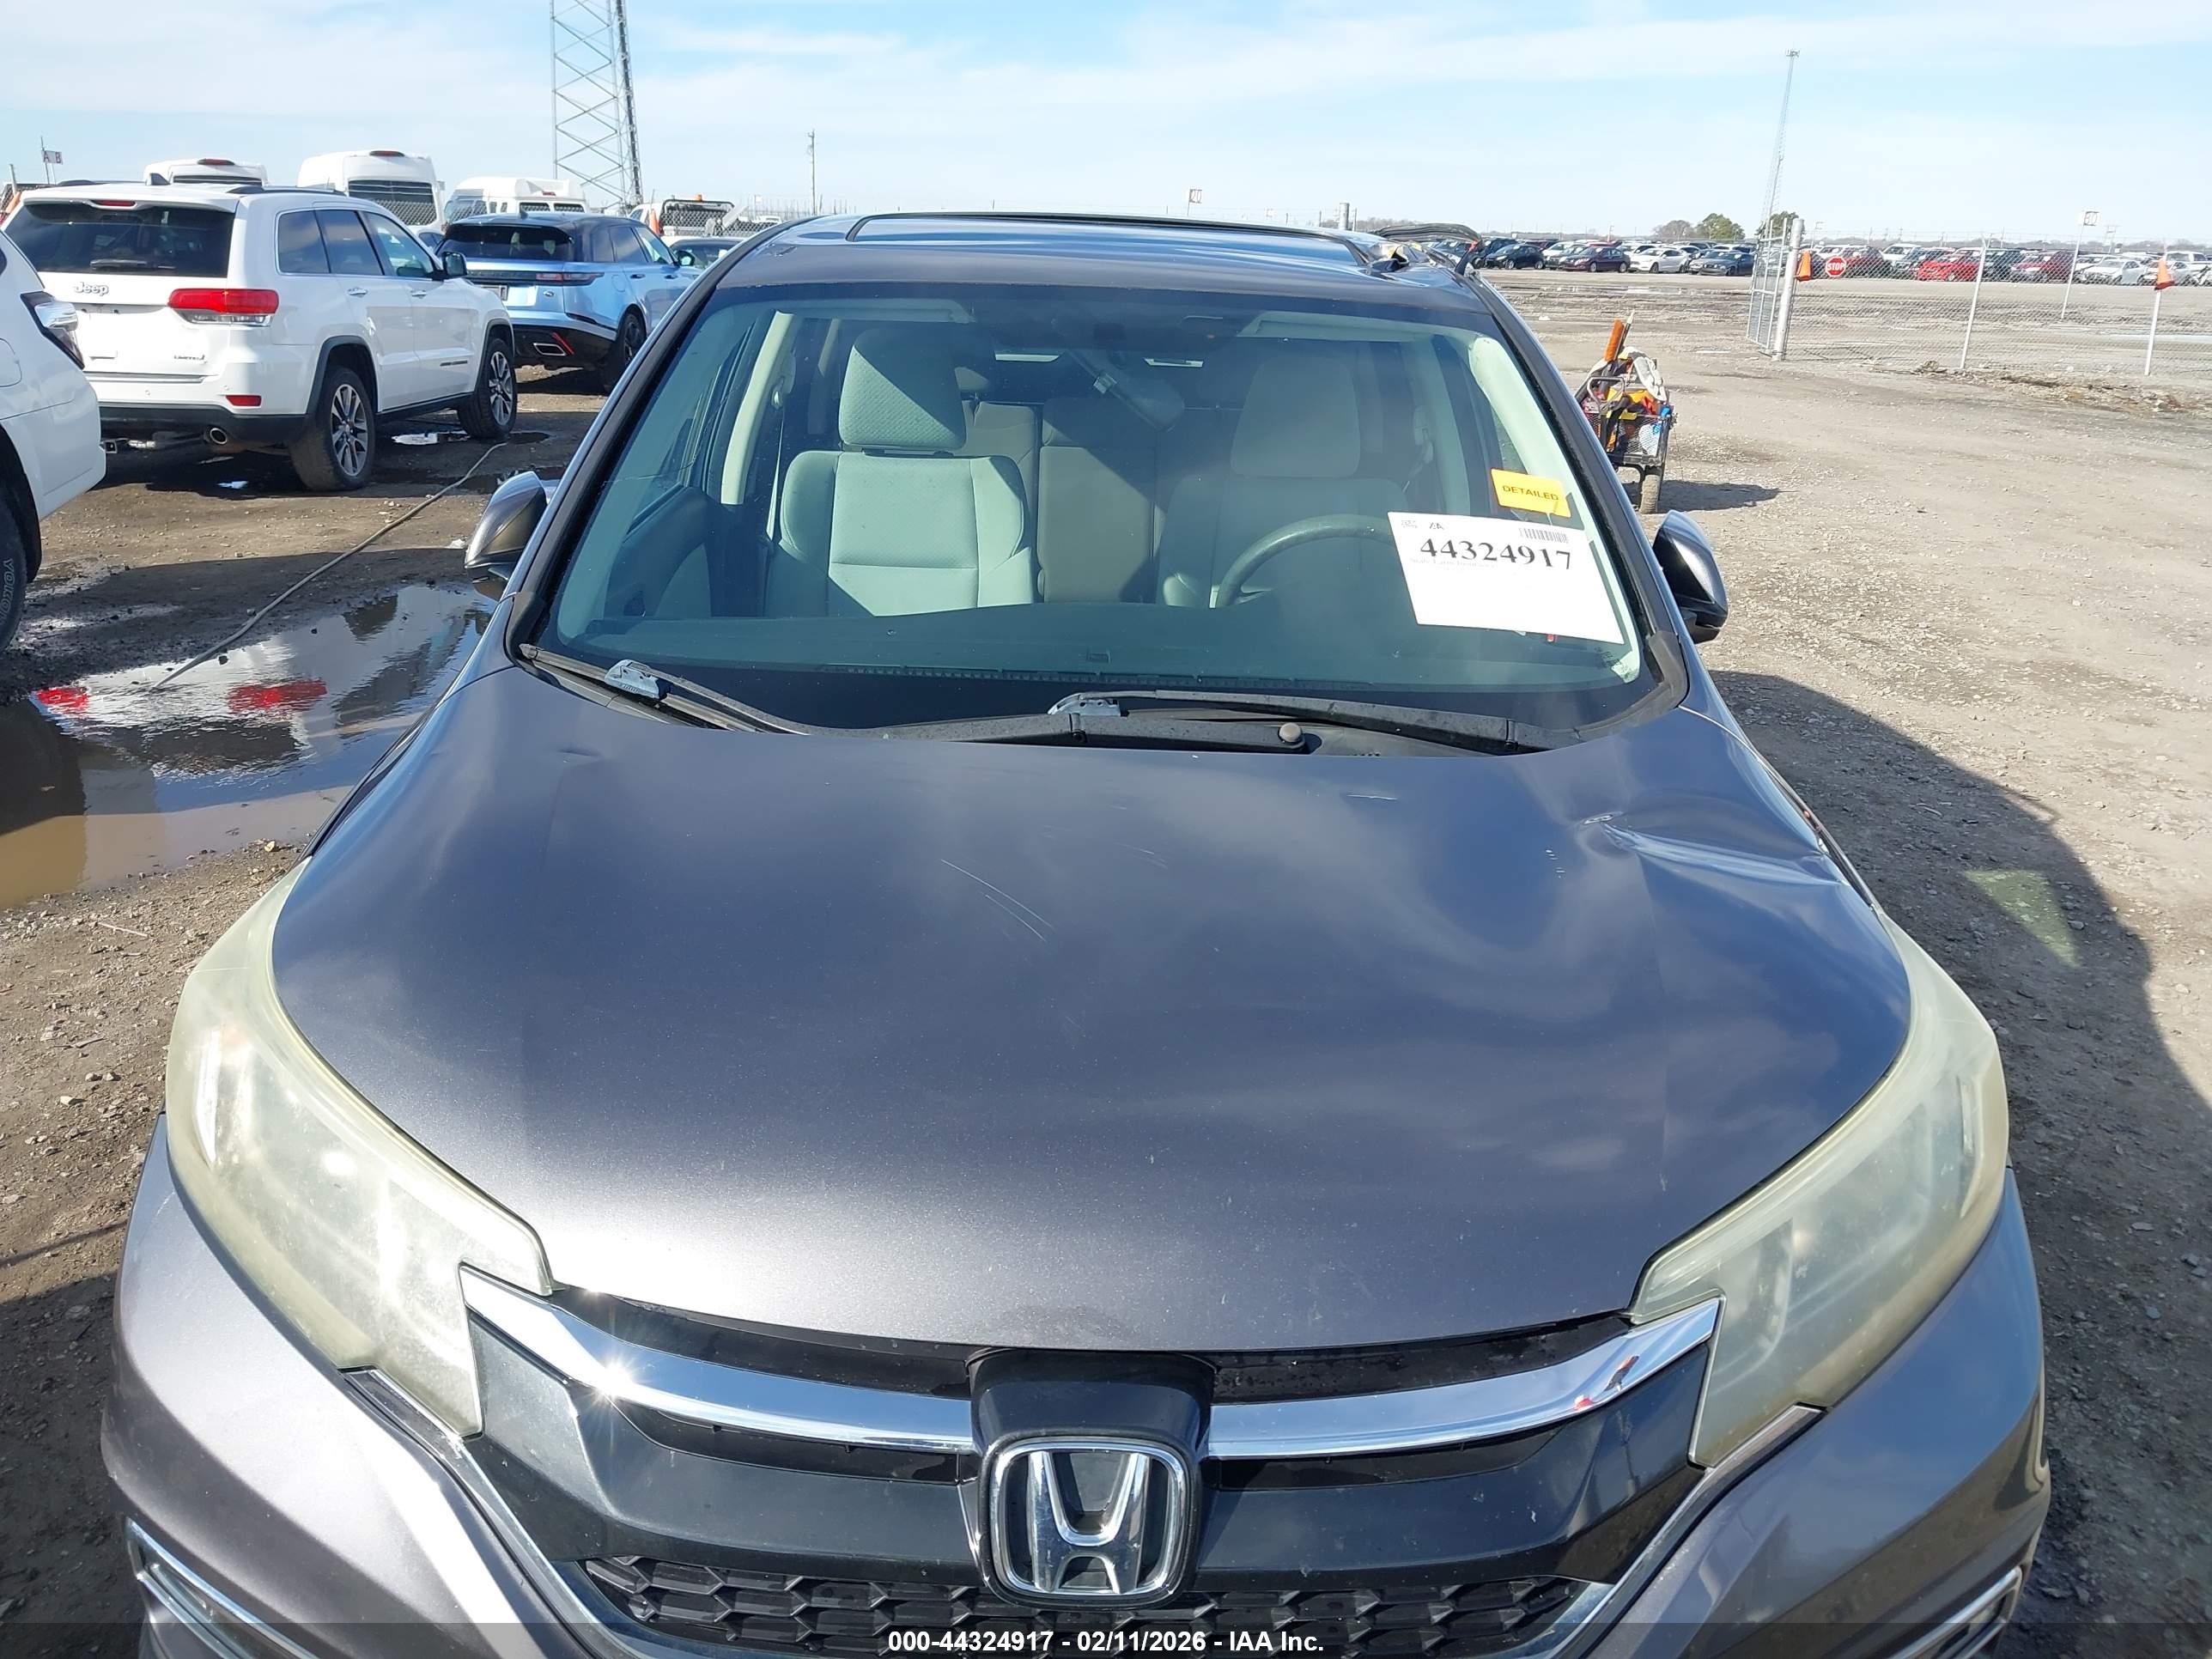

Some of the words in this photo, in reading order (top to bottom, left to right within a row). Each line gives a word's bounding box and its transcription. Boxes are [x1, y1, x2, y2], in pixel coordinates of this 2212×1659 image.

[1826, 262, 1845, 271] STOP
[72, 281, 110, 297] Jeep
[1502, 485, 1559, 501] DETAILED
[1419, 538, 1572, 570] 44324917
